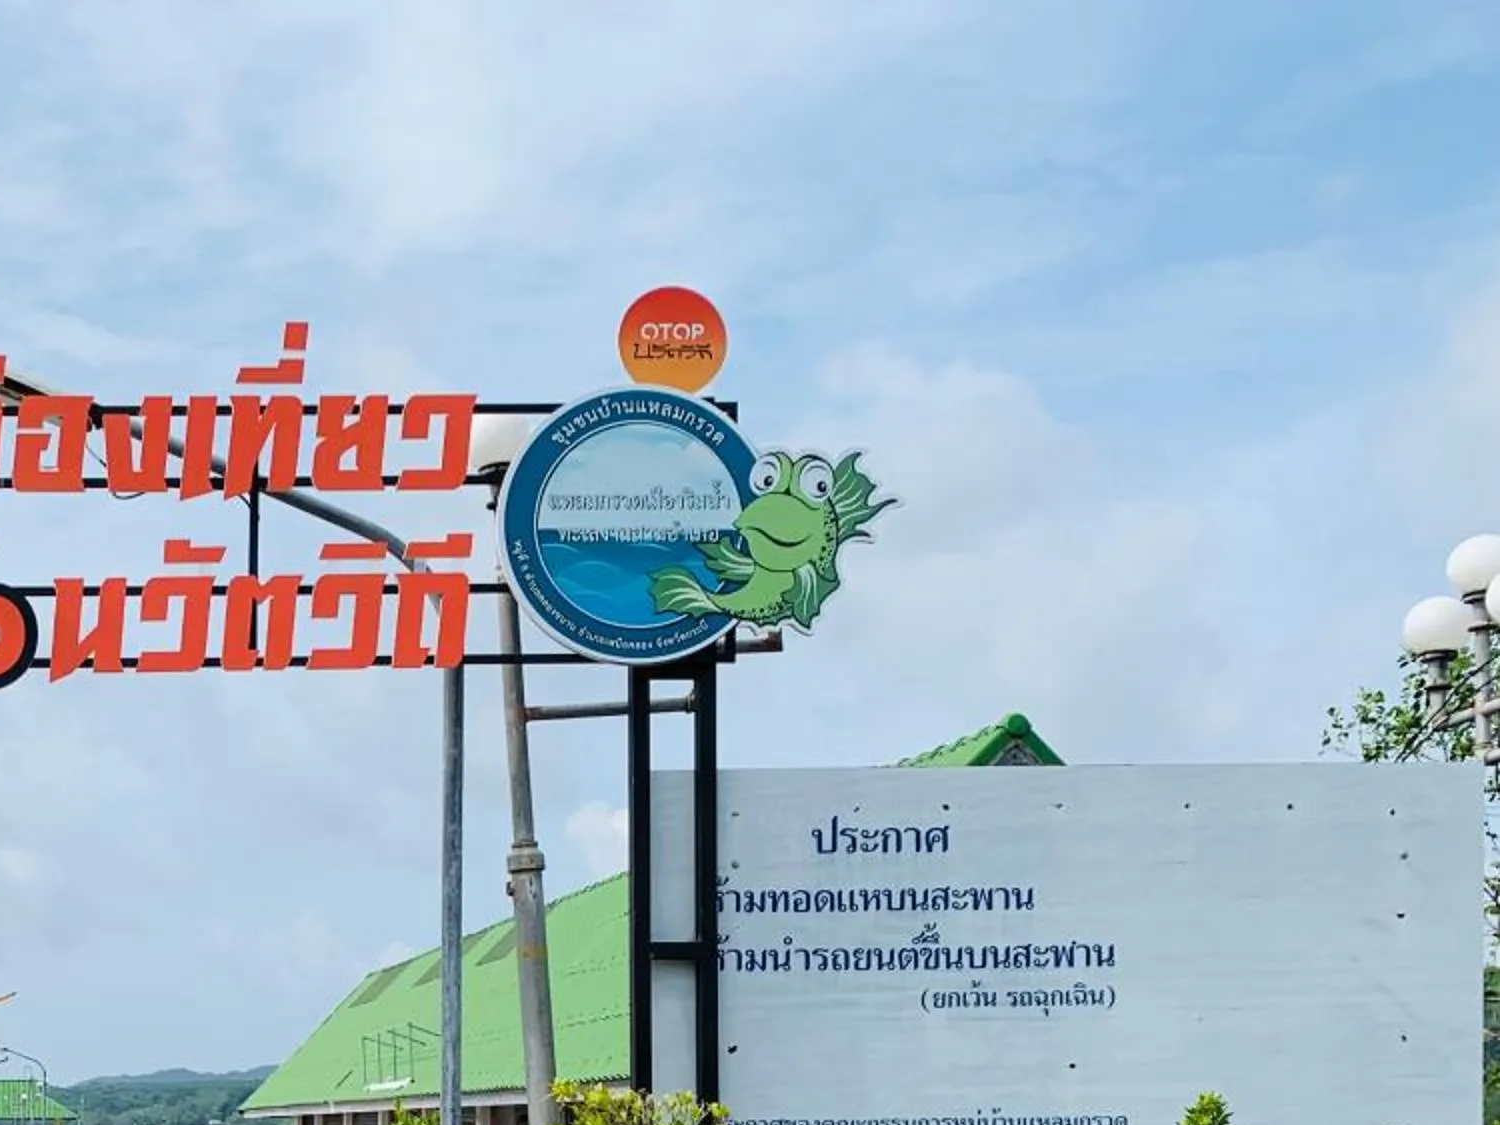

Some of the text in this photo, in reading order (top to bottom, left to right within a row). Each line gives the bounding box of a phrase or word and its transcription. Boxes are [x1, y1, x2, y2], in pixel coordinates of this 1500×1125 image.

[641, 323, 705, 340] OTOP
[551, 396, 727, 447] ชุมชนบ้านแหลมกรวด
[49, 532, 473, 683] นวัตวิถี
[812, 816, 949, 854] ประกาศ
[921, 981, 1115, 1016] (ยกเว้น รถฉุกเฉิน)
